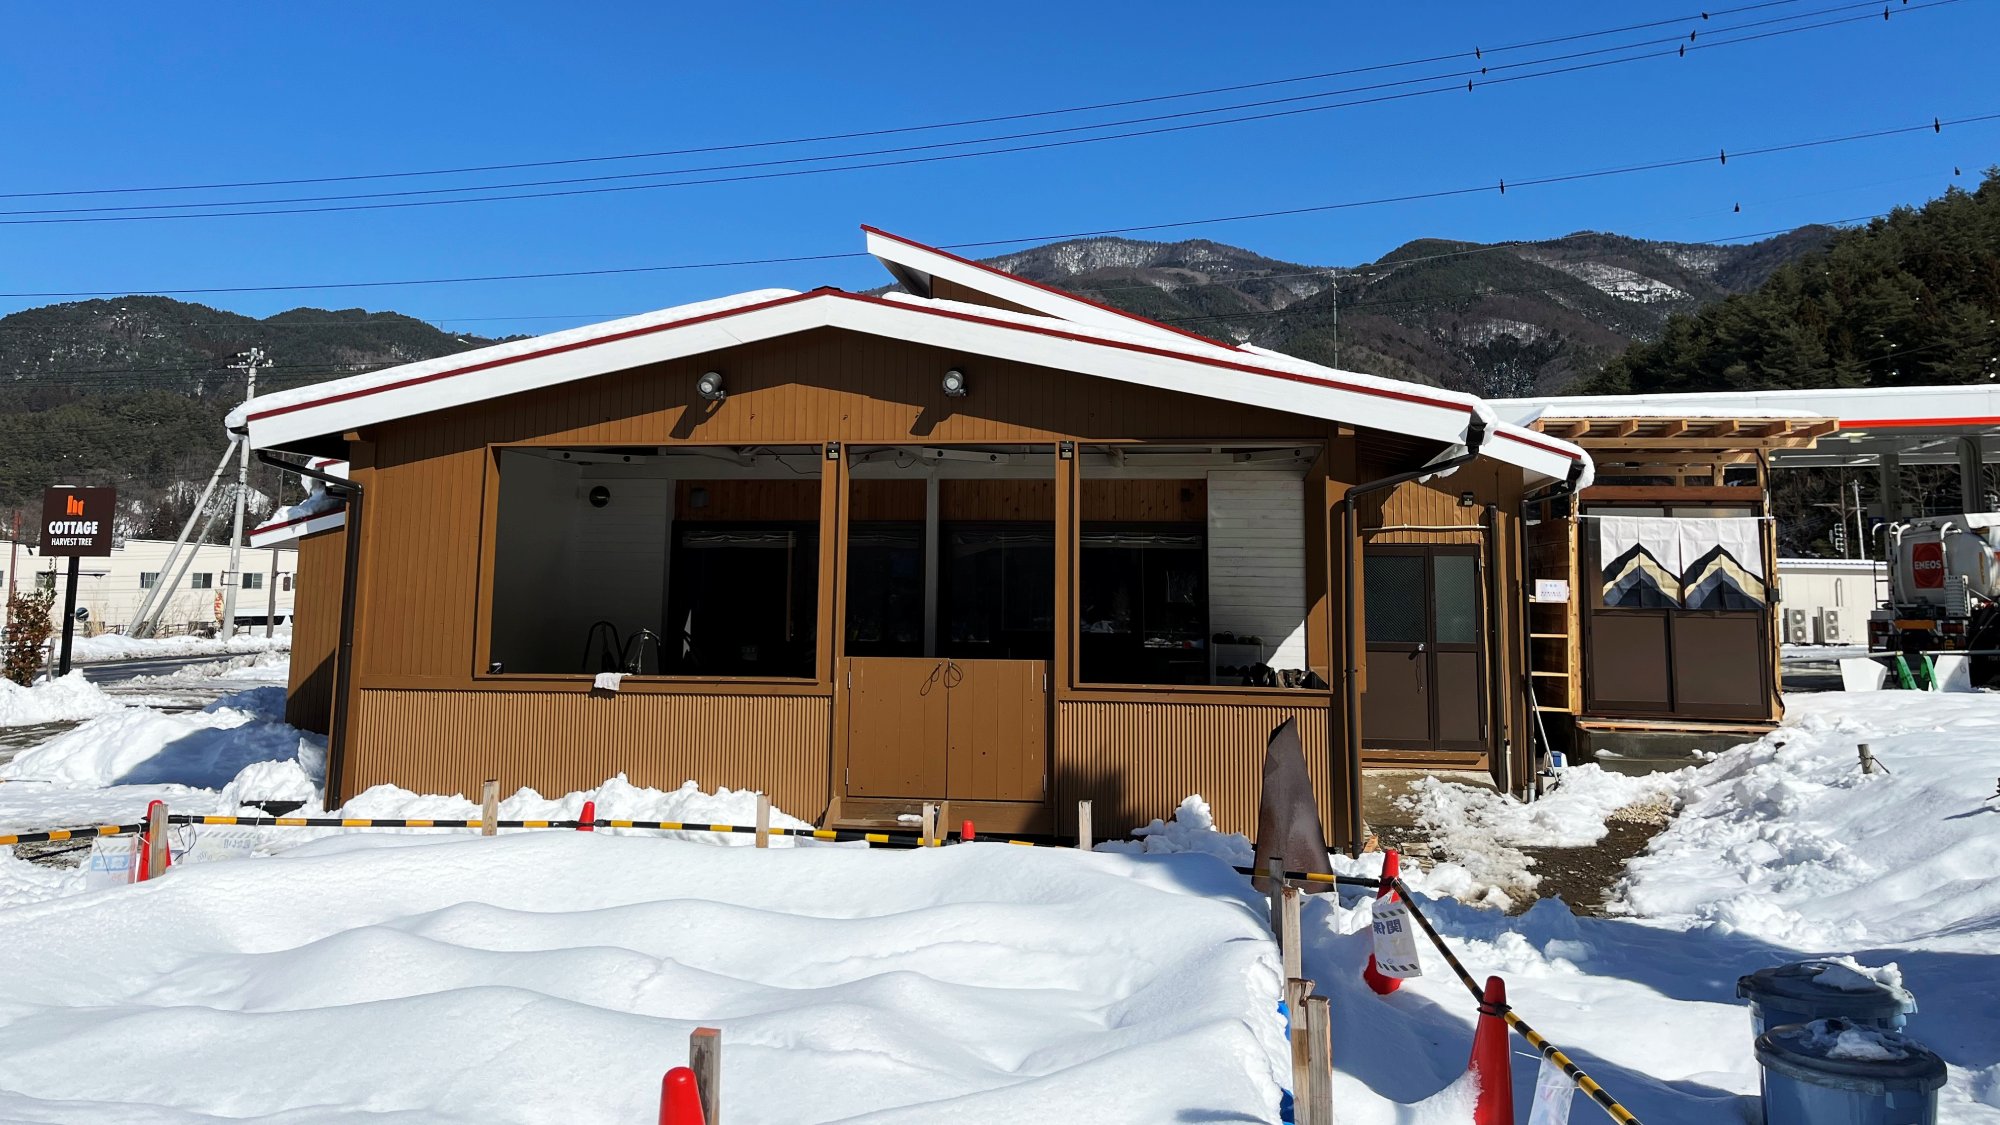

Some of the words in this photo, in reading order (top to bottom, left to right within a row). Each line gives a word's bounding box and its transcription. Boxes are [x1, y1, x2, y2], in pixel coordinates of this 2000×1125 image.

[48, 521, 99, 535] COTTAGE
[51, 537, 77, 546] HARVEST
[78, 537, 93, 546] TREE
[1914, 559, 1942, 570] ENEOS
